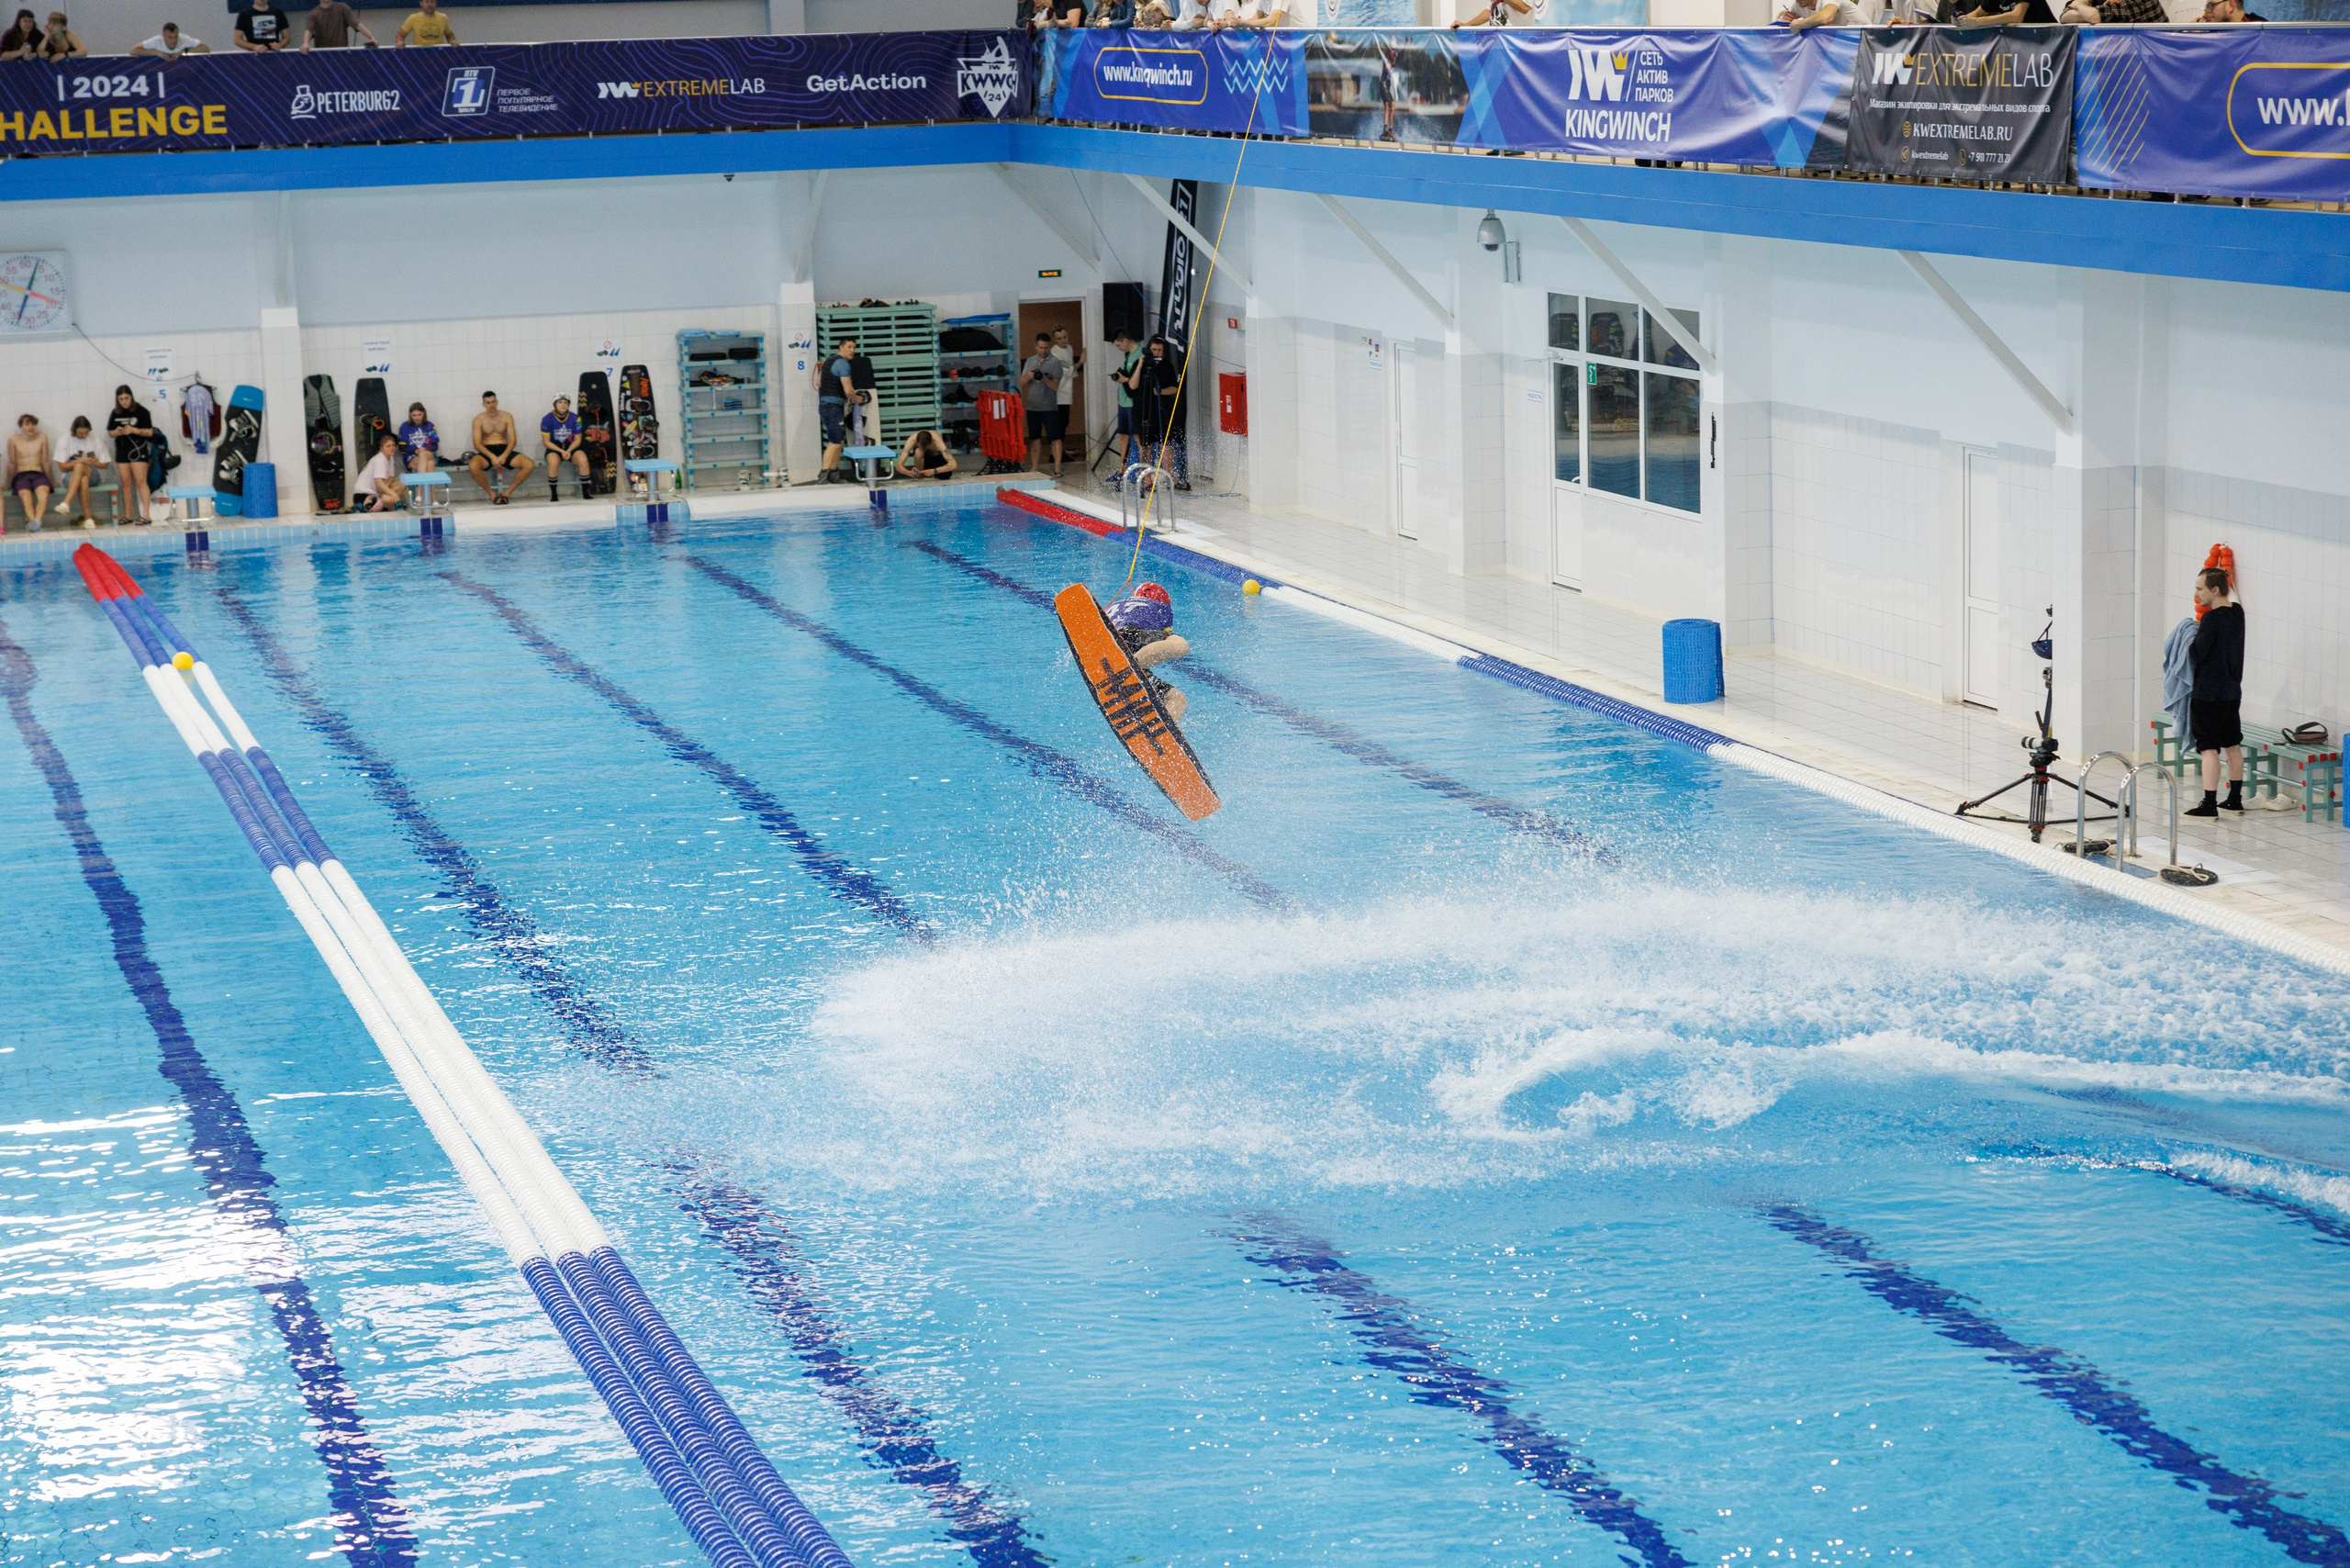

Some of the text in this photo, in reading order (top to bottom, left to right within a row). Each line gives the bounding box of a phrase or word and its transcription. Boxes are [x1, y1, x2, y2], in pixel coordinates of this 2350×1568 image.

[1640, 51, 1663, 66] СЕТЬ
[1916, 52, 2053, 87] EXTREMELAB
[1637, 70, 1668, 84] АКТИВ
[73, 75, 150, 98] 2024
[643, 78, 766, 97] EXTREMELAB
[806, 73, 926, 92] GetAction
[497, 88, 531, 96] ПЕРВОЕ
[1635, 87, 1673, 103] ПАРКОВ
[498, 95, 554, 105] ПОПУЛЯРНОЕ
[498, 104, 558, 113] ТЕЛЕВИДЕНИЕ
[1870, 98, 1897, 108] Магазин
[1897, 101, 1938, 112] экипировки
[2005, 104, 2027, 113] видов
[2028, 105, 2051, 113] спорта
[1565, 109, 1672, 142] KINGWINCH
[1912, 123, 2013, 141] KWEXTREMELAB.RU
[1911, 151, 1949, 161] kwextremelab
[1986, 153, 1997, 162] 777
[19, 261, 31, 269] 60
[39, 265, 45, 274] 5
[6, 266, 17, 275] 55
[44, 274, 55, 283] 10
[38, 310, 49, 319] 25
[24, 316, 36, 325] 30
[797, 360, 805, 371] 8
[606, 367, 614, 377] 7
[159, 389, 166, 399] 5
